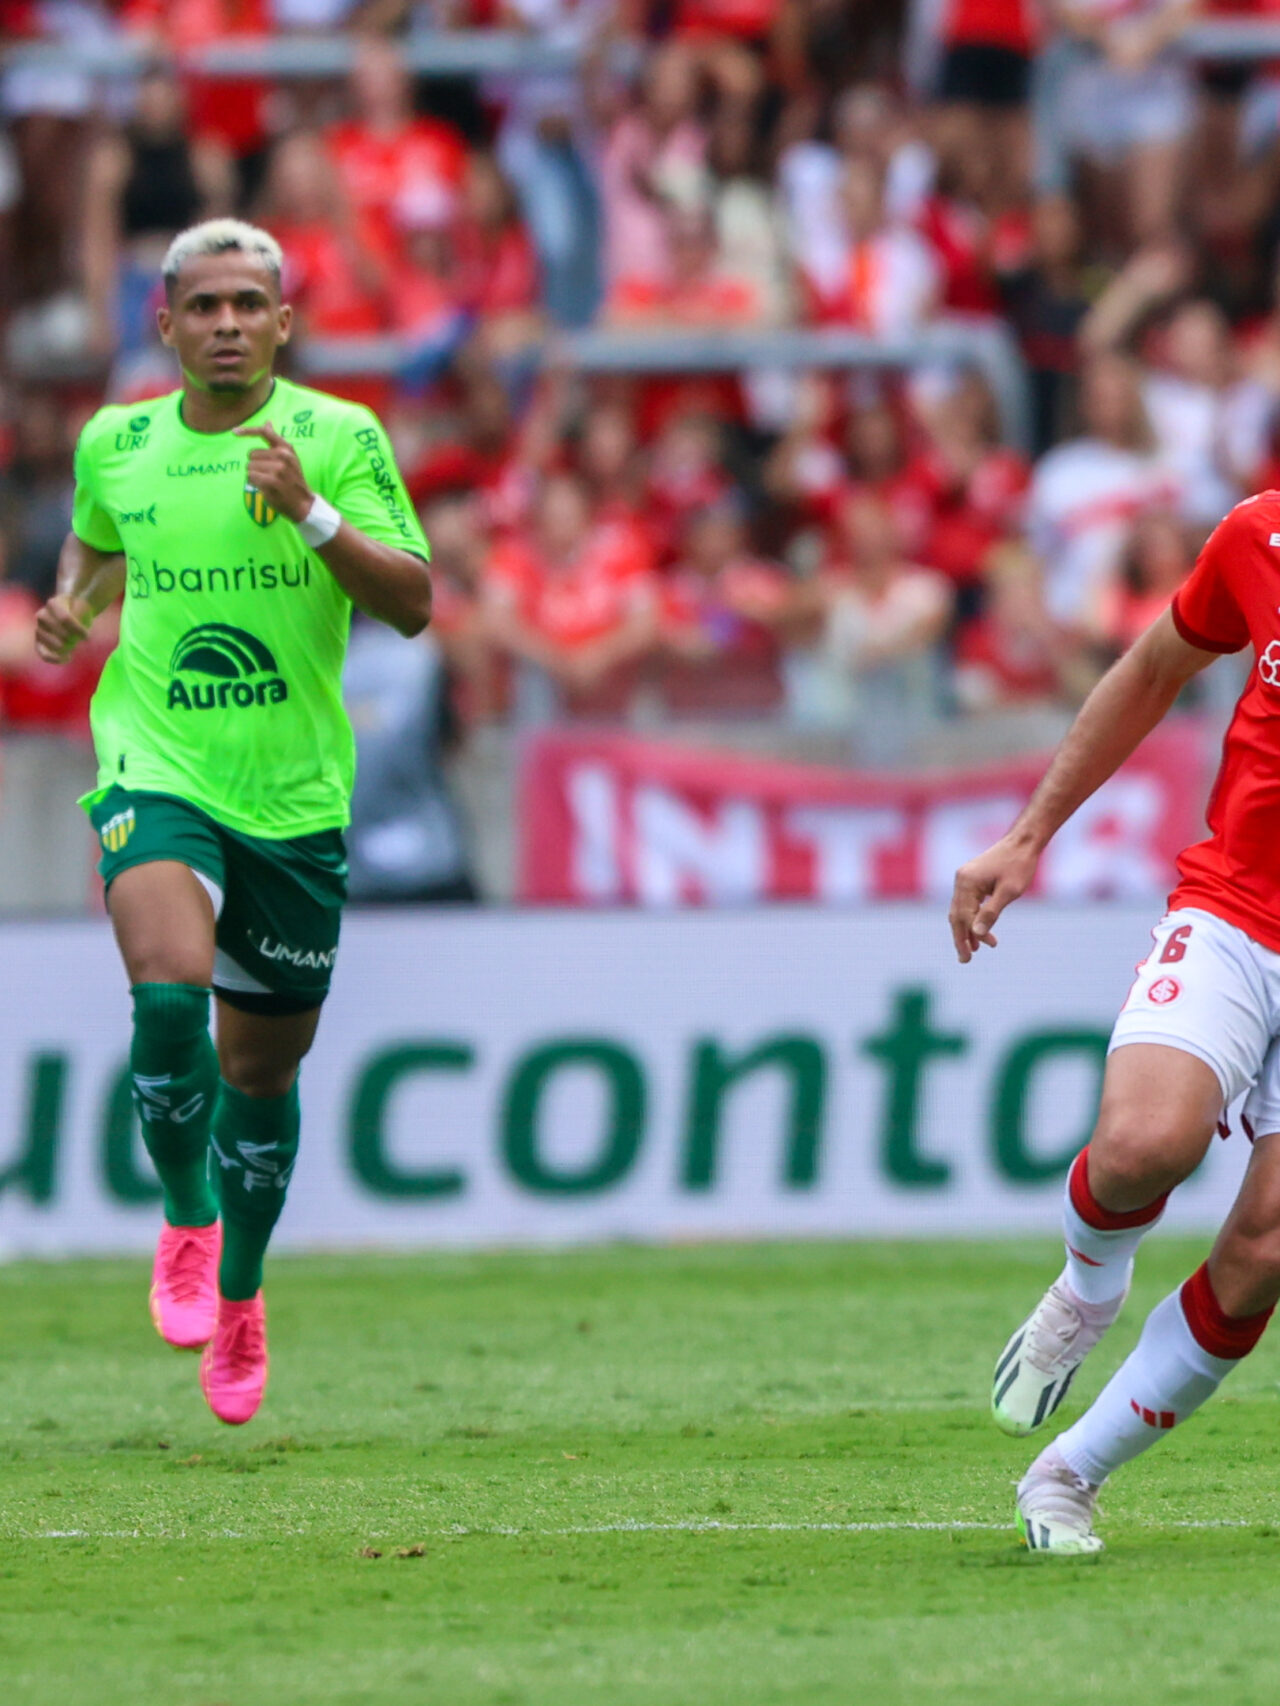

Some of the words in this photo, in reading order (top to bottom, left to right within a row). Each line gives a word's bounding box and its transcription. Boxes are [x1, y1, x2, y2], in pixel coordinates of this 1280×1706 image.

[153, 557, 310, 593] banrisul
[166, 677, 288, 711] Aurora
[566, 756, 1168, 906] INTER
[1159, 925, 1193, 964] 6
